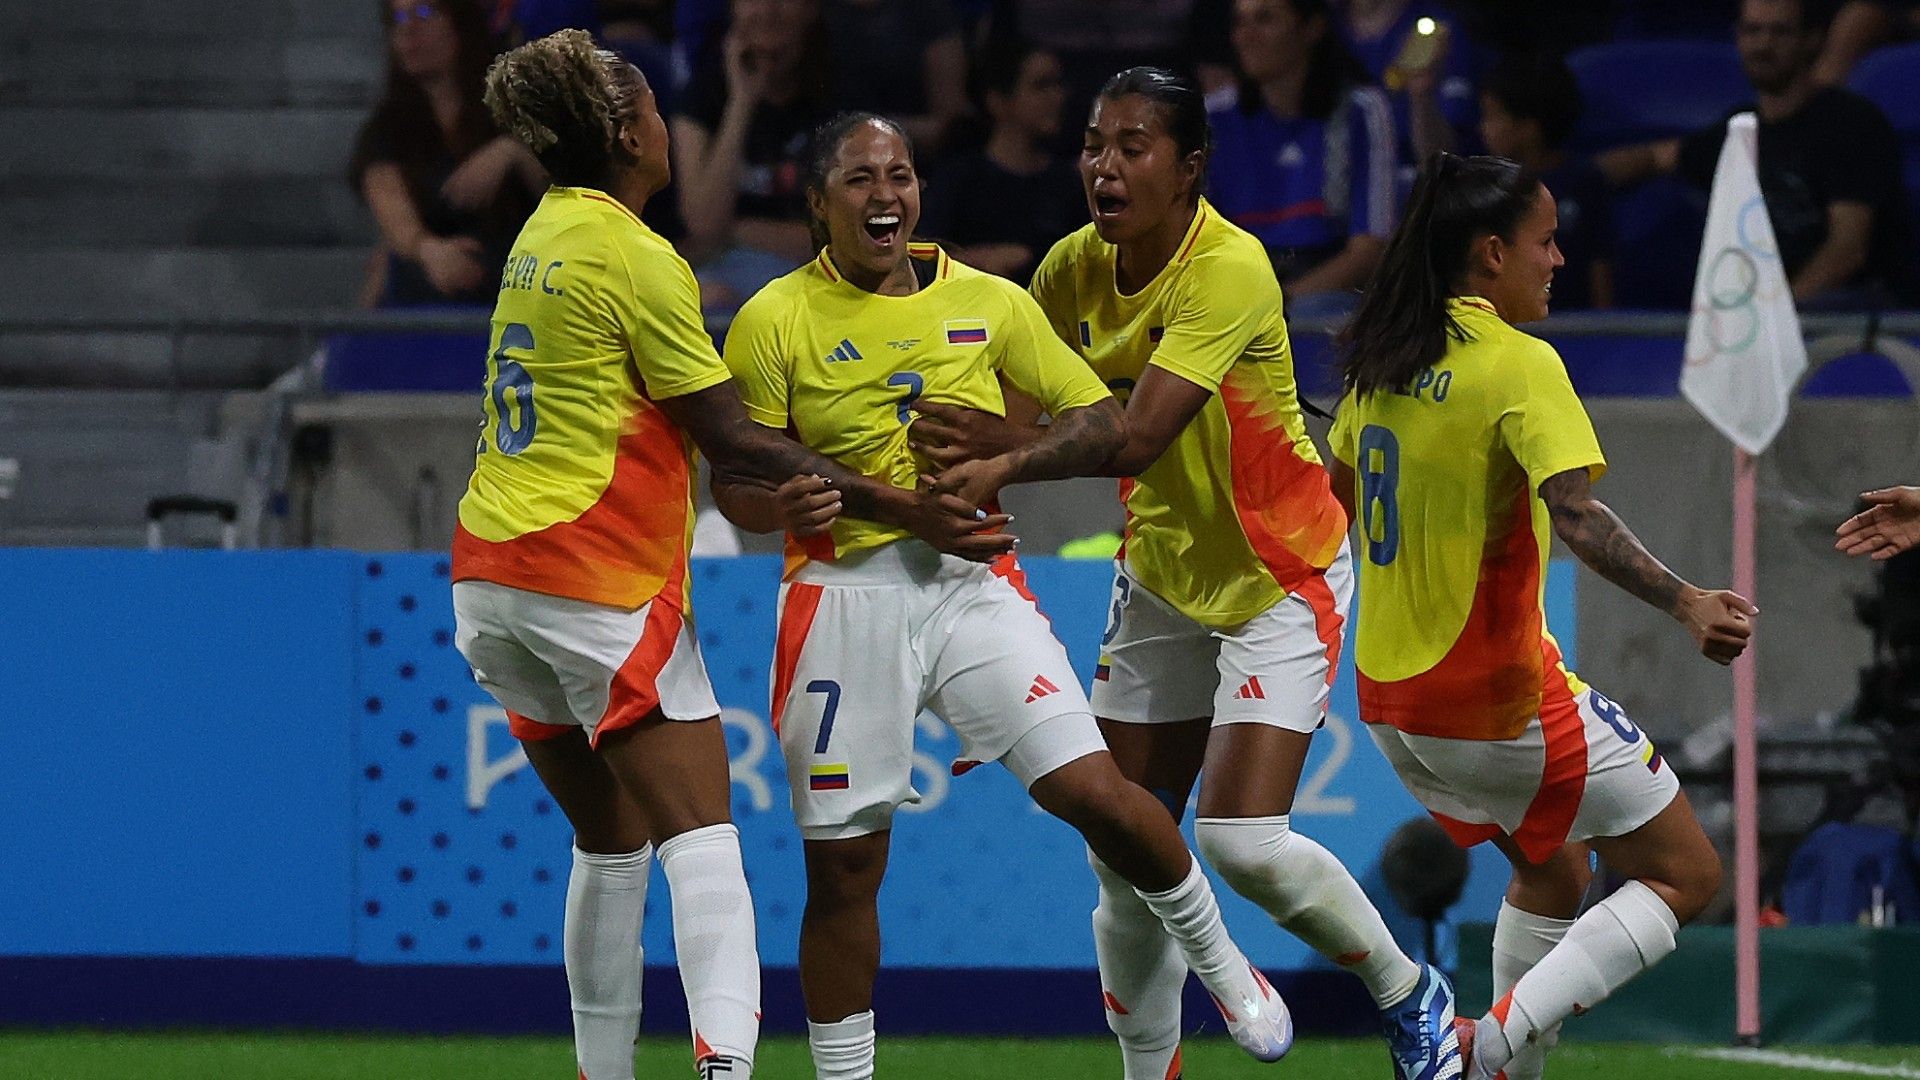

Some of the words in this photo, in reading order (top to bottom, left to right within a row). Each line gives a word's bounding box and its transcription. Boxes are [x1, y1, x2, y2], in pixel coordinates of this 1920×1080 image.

[1360, 424, 1400, 566] 8
[806, 680, 841, 754] 7
[1589, 689, 1640, 743] 8
